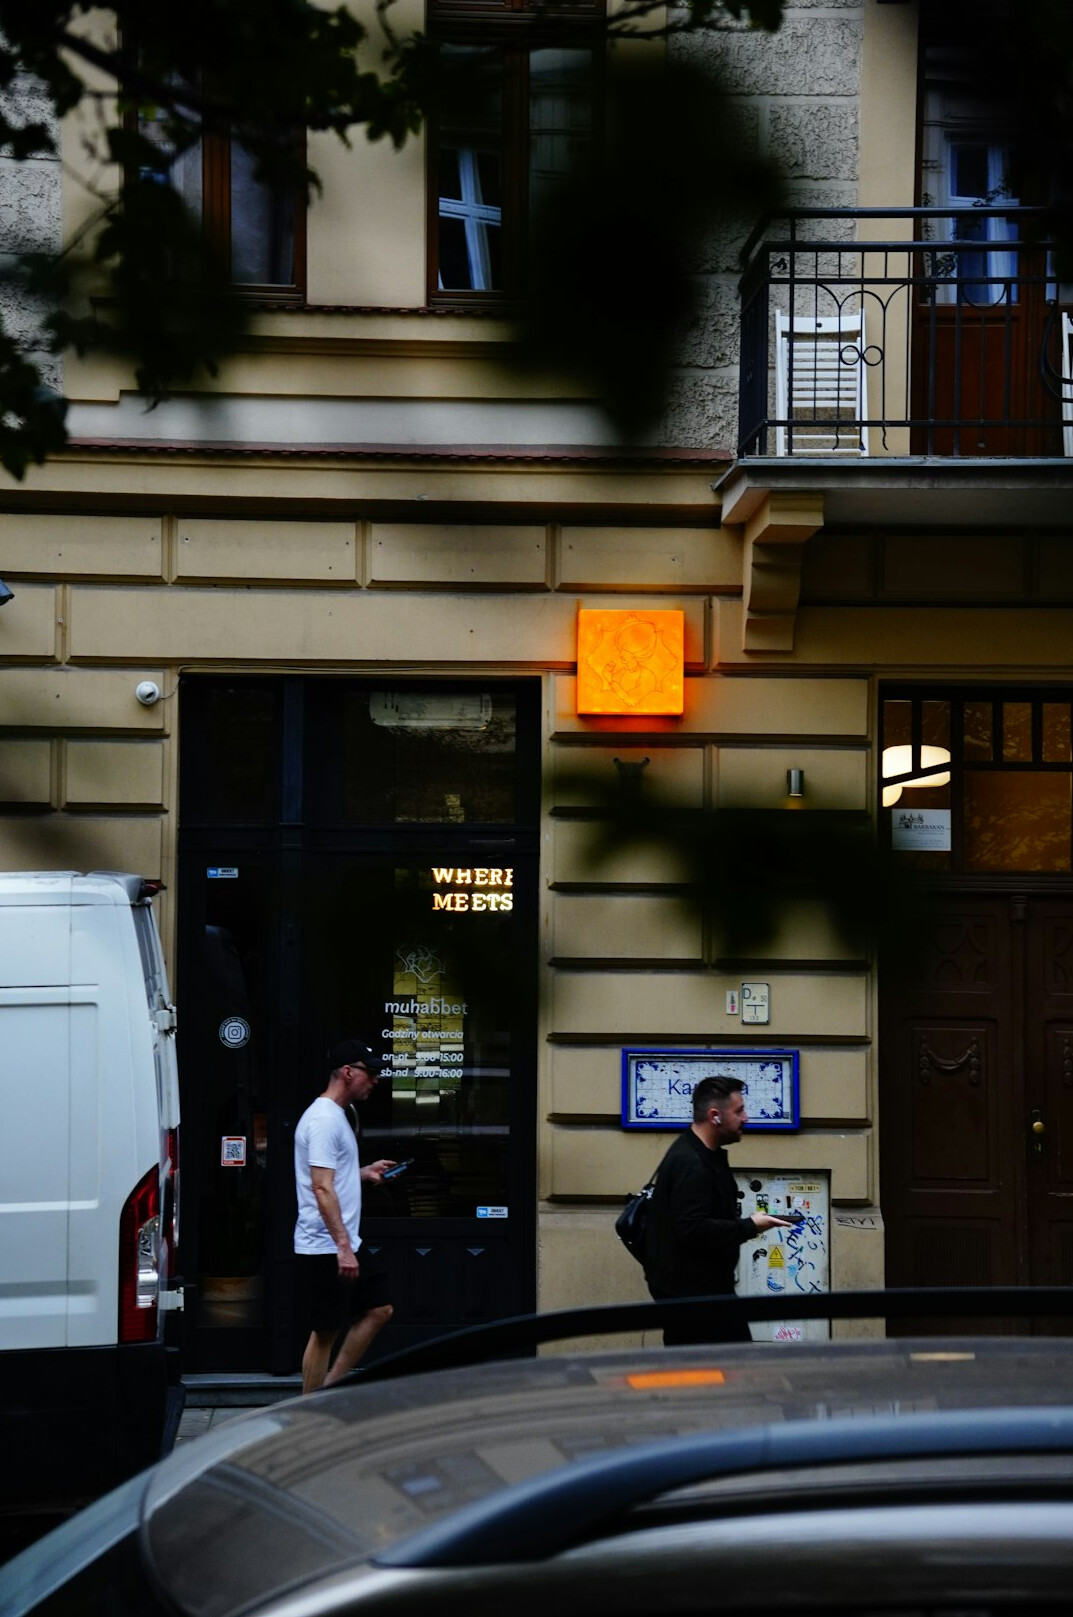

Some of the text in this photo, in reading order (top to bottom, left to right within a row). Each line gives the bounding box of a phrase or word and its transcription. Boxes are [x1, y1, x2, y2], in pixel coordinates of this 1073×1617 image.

[432, 893, 513, 911] MEETS
[384, 997, 468, 1015] muhabbet
[381, 1029, 464, 1040] Godziny otwarcia
[380, 1068, 408, 1077] sb-nd
